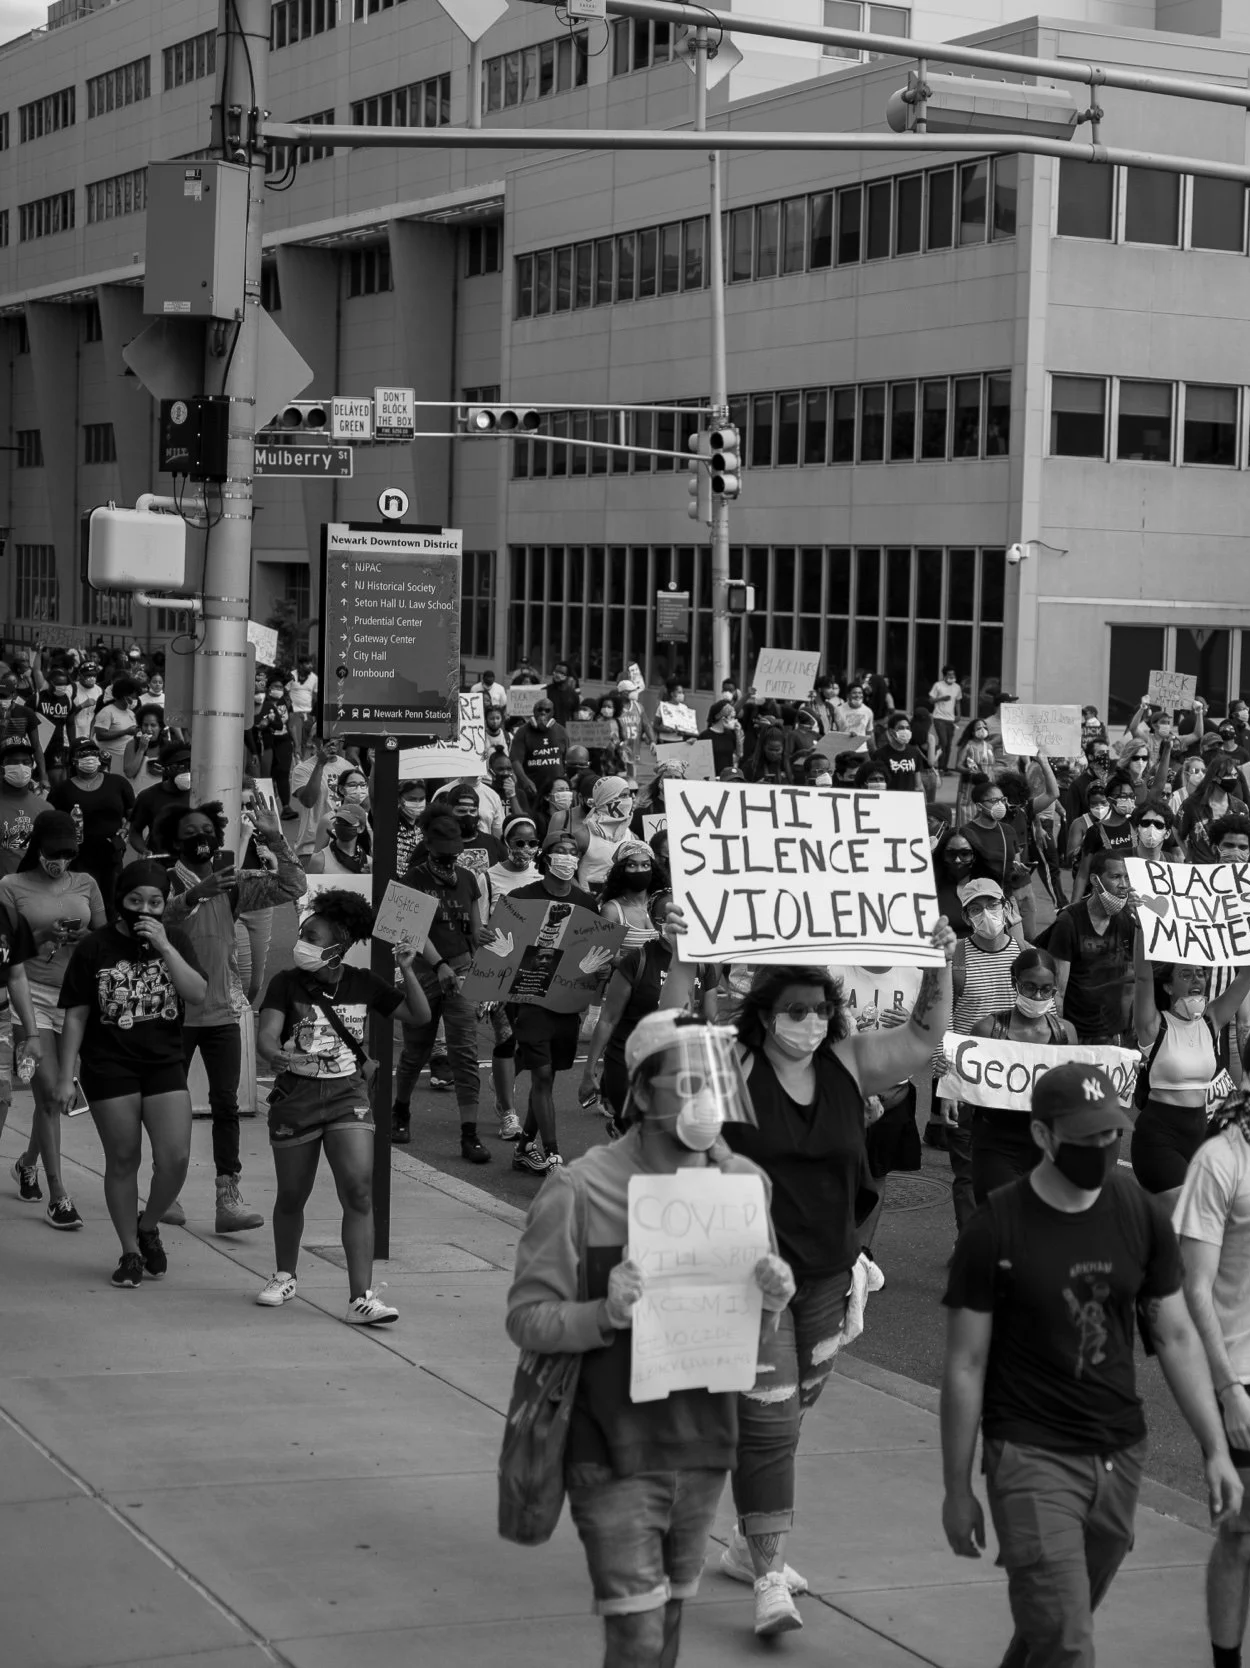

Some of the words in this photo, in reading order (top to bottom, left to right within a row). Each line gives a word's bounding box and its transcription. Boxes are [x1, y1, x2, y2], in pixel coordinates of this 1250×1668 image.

[384, 392, 406, 402] DON'T
[334, 404, 369, 417] DELAYED
[382, 404, 408, 414] BLOCK
[339, 420, 364, 432] GREEN
[378, 416, 393, 426] THE
[396, 416, 412, 426] BOX
[255, 449, 332, 469] Mulberry
[338, 450, 348, 460] St
[331, 535, 368, 545] Newark
[370, 537, 421, 547] Downtown
[423, 539, 458, 549] District
[355, 563, 382, 573] NJPAC
[354, 581, 365, 590] NJ
[367, 581, 405, 592] Historical
[407, 582, 436, 595] Society
[354, 598, 378, 608] Seton
[380, 598, 396, 608] Hall
[398, 599, 407, 609] U.
[409, 599, 426, 609] Law
[428, 600, 454, 610] School
[354, 616, 395, 627] Prudential
[396, 617, 423, 627] Center
[353, 634, 388, 645] Gateway
[390, 634, 416, 644] Center
[353, 651, 369, 662] City
[371, 651, 387, 661] Hall
[352, 668, 395, 678] Ironbound
[374, 709, 402, 718] Newark
[404, 710, 423, 719] Penn
[424, 710, 451, 719] Station
[532, 746, 560, 756] CAN'T
[679, 788, 880, 834] WHITE
[680, 833, 869, 876] SILENCE
[883, 837, 928, 874] IS
[387, 883, 420, 914] Justice
[685, 888, 938, 945] VIOLENCE
[467, 961, 495, 978] Hands
[497, 966, 513, 990] up
[633, 1194, 758, 1240] COVID
